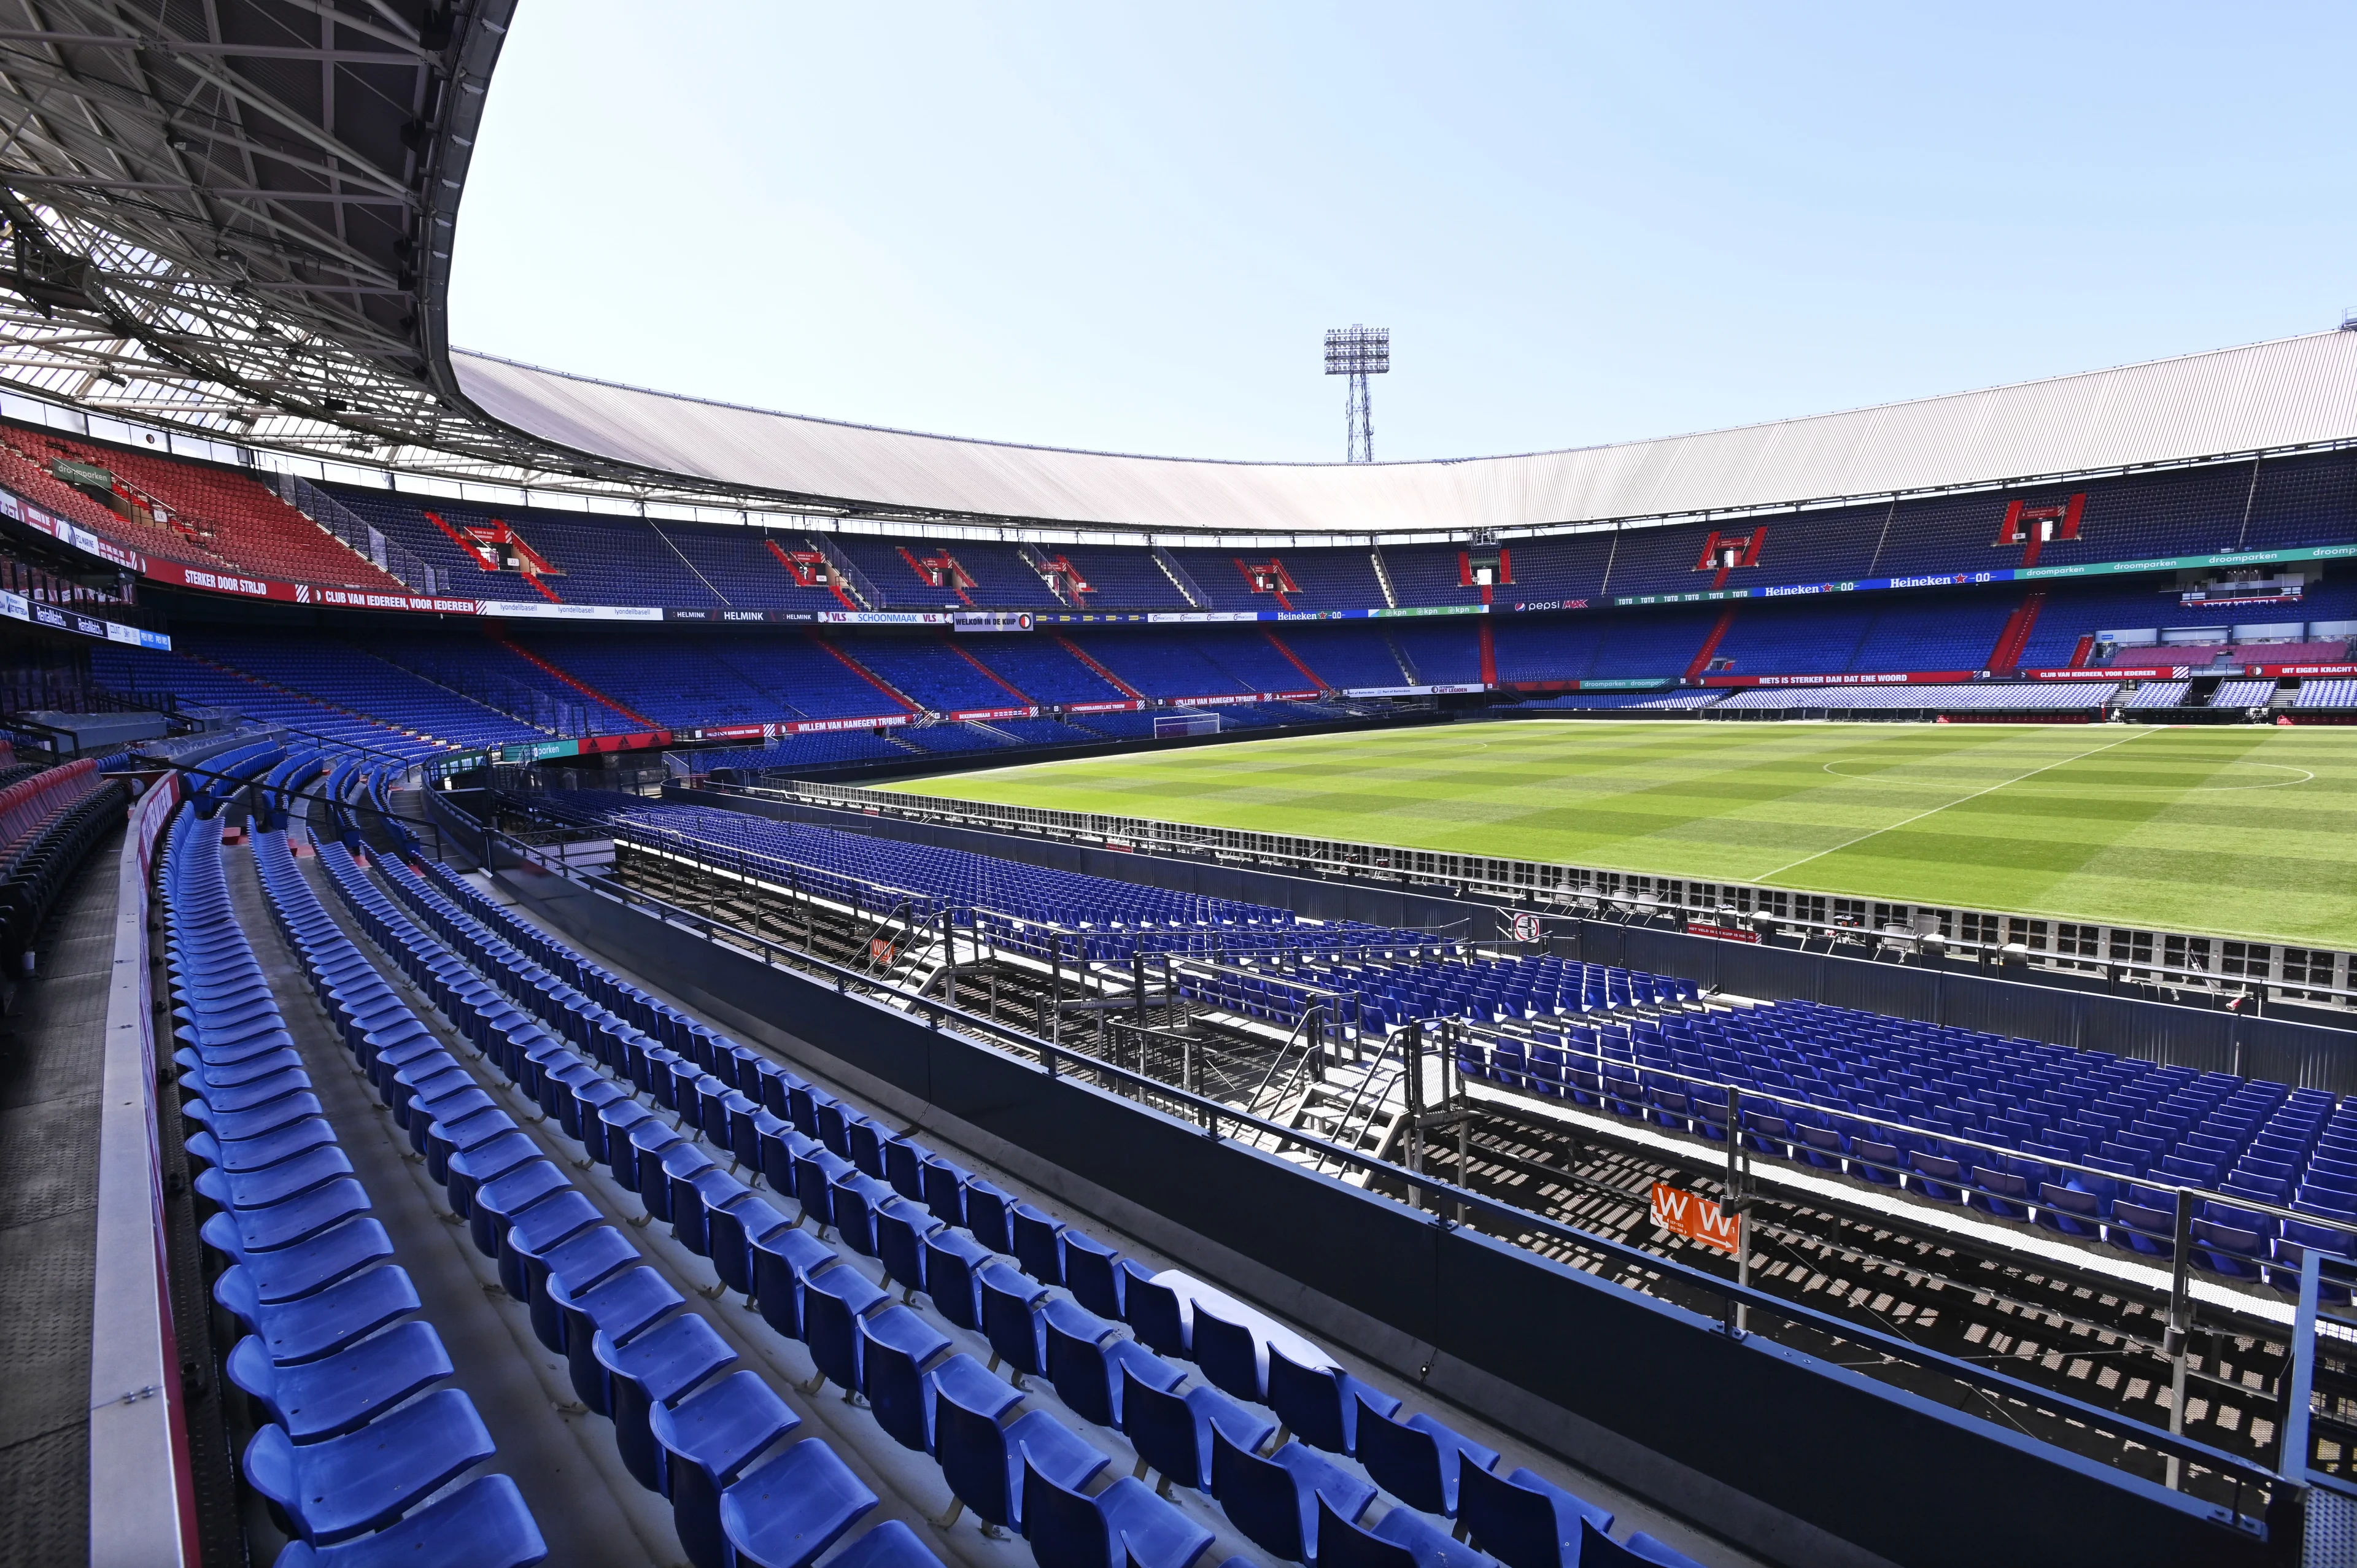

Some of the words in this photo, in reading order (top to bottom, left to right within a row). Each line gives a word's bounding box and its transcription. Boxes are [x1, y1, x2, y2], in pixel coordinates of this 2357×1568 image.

[82, 535, 95, 549] MARINE
[2313, 547, 2357, 556] droomp
[2209, 553, 2277, 564] droomparken
[2027, 566, 2084, 576] droomparken
[2114, 560, 2177, 570] droomparken
[185, 569, 216, 588] STERKER
[217, 576, 239, 592] DOOR
[240, 579, 266, 595] STRIJD
[1890, 576, 1951, 588] Heineken
[1765, 585, 1819, 597] Heineken
[325, 590, 346, 603] CLUB
[347, 593, 365, 605] VAN
[367, 595, 409, 610] IEDEREEN,
[409, 598, 432, 610] VOOR
[434, 600, 474, 612] IEDEREEN
[1528, 600, 1560, 611] pepsi
[1562, 599, 1589, 609] MAX
[500, 603, 537, 612] lyondellbasell
[724, 611, 764, 620] HELMINK
[831, 613, 846, 622] VLS
[857, 613, 917, 622] SCHOONMAAK
[923, 614, 937, 622] VLS
[1277, 612, 1317, 620] Heineken
[798, 722, 826, 732] WILLEM
[827, 721, 842, 730] VAN
[843, 719, 877, 728] HANEGEM
[878, 716, 906, 726] TRIBUNE
[461, 757, 473, 771] TOTO
[872, 939, 881, 954] W
[1657, 1187, 1689, 1221] W
[1698, 1201, 1733, 1237] W
